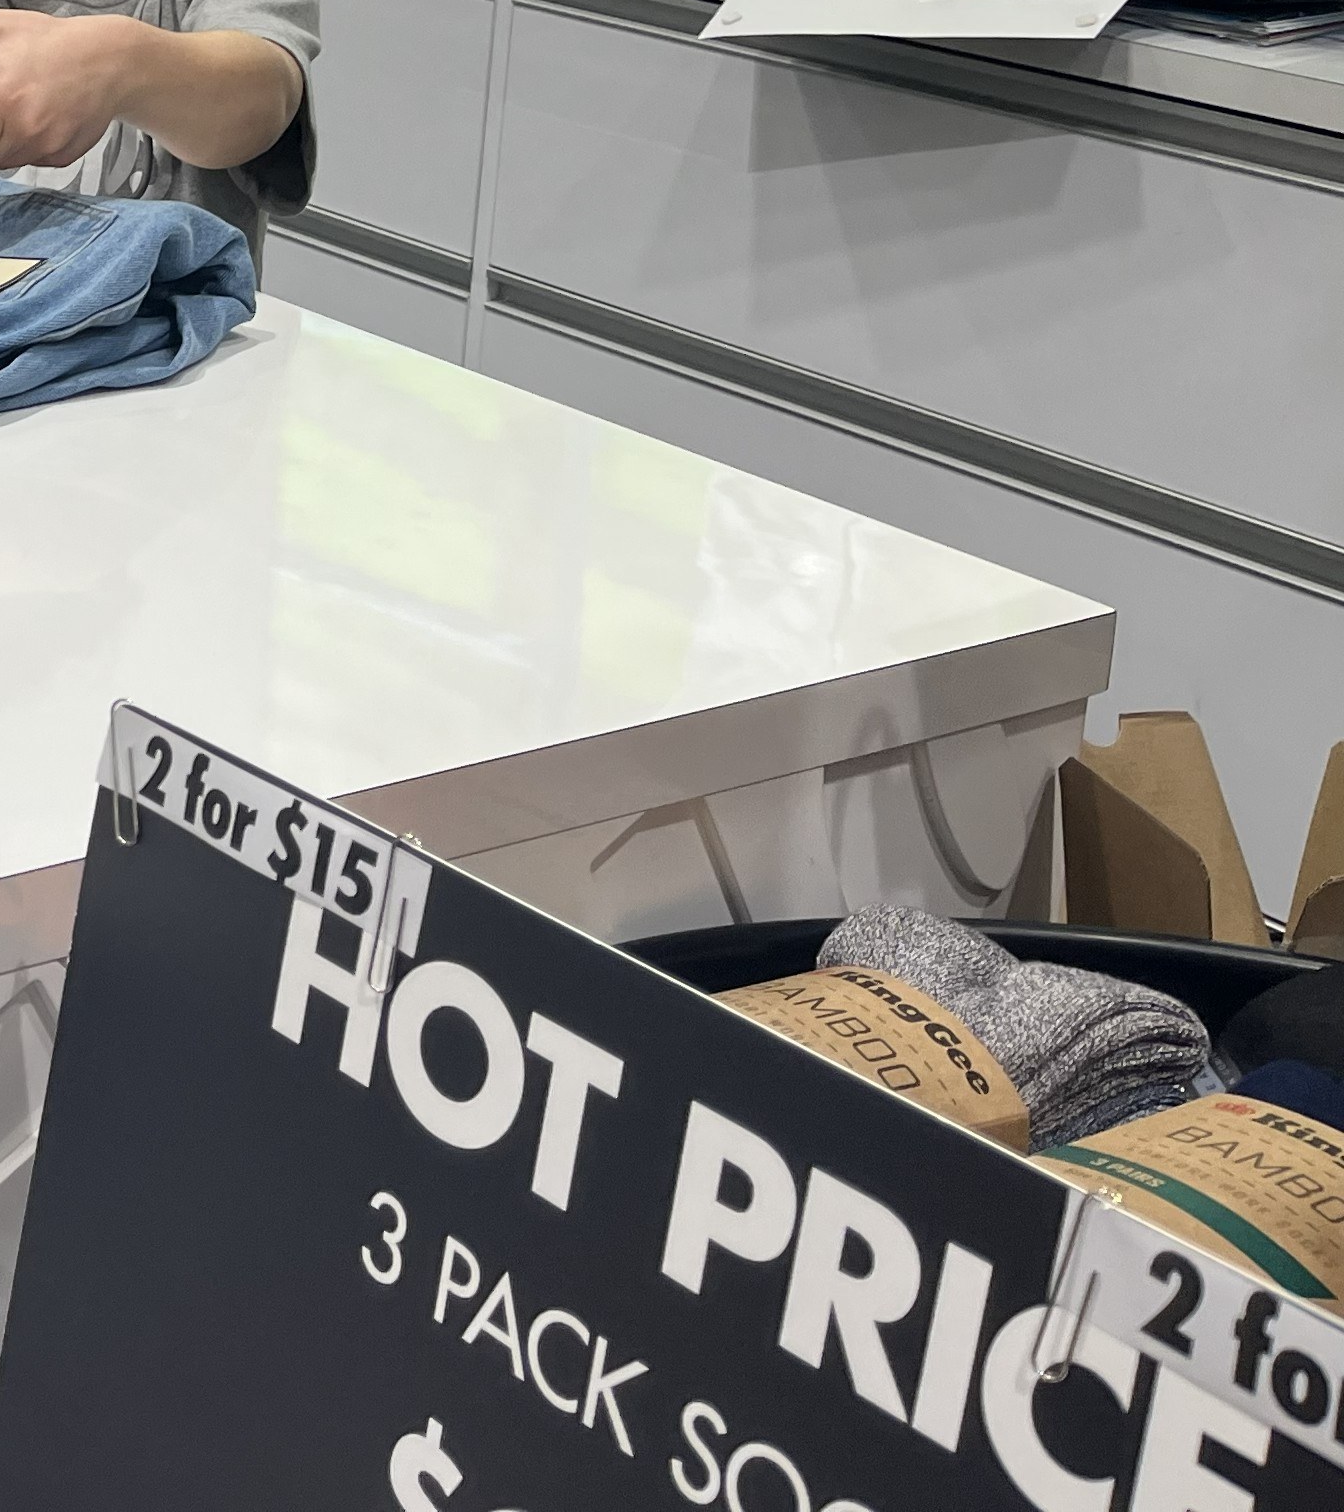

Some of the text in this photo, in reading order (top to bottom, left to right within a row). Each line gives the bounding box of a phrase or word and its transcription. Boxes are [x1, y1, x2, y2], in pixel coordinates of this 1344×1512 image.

[139, 736, 380, 917] 2 for $15
[829, 969, 991, 1096] KingGee
[271, 898, 625, 1213] HOT
[660, 1099, 1275, 1512] PRICE
[1108, 1161, 1168, 1189] PAIRS
[361, 1191, 892, 1512] 3 PACK SO
[1140, 1250, 1344, 1443] 2 fo
